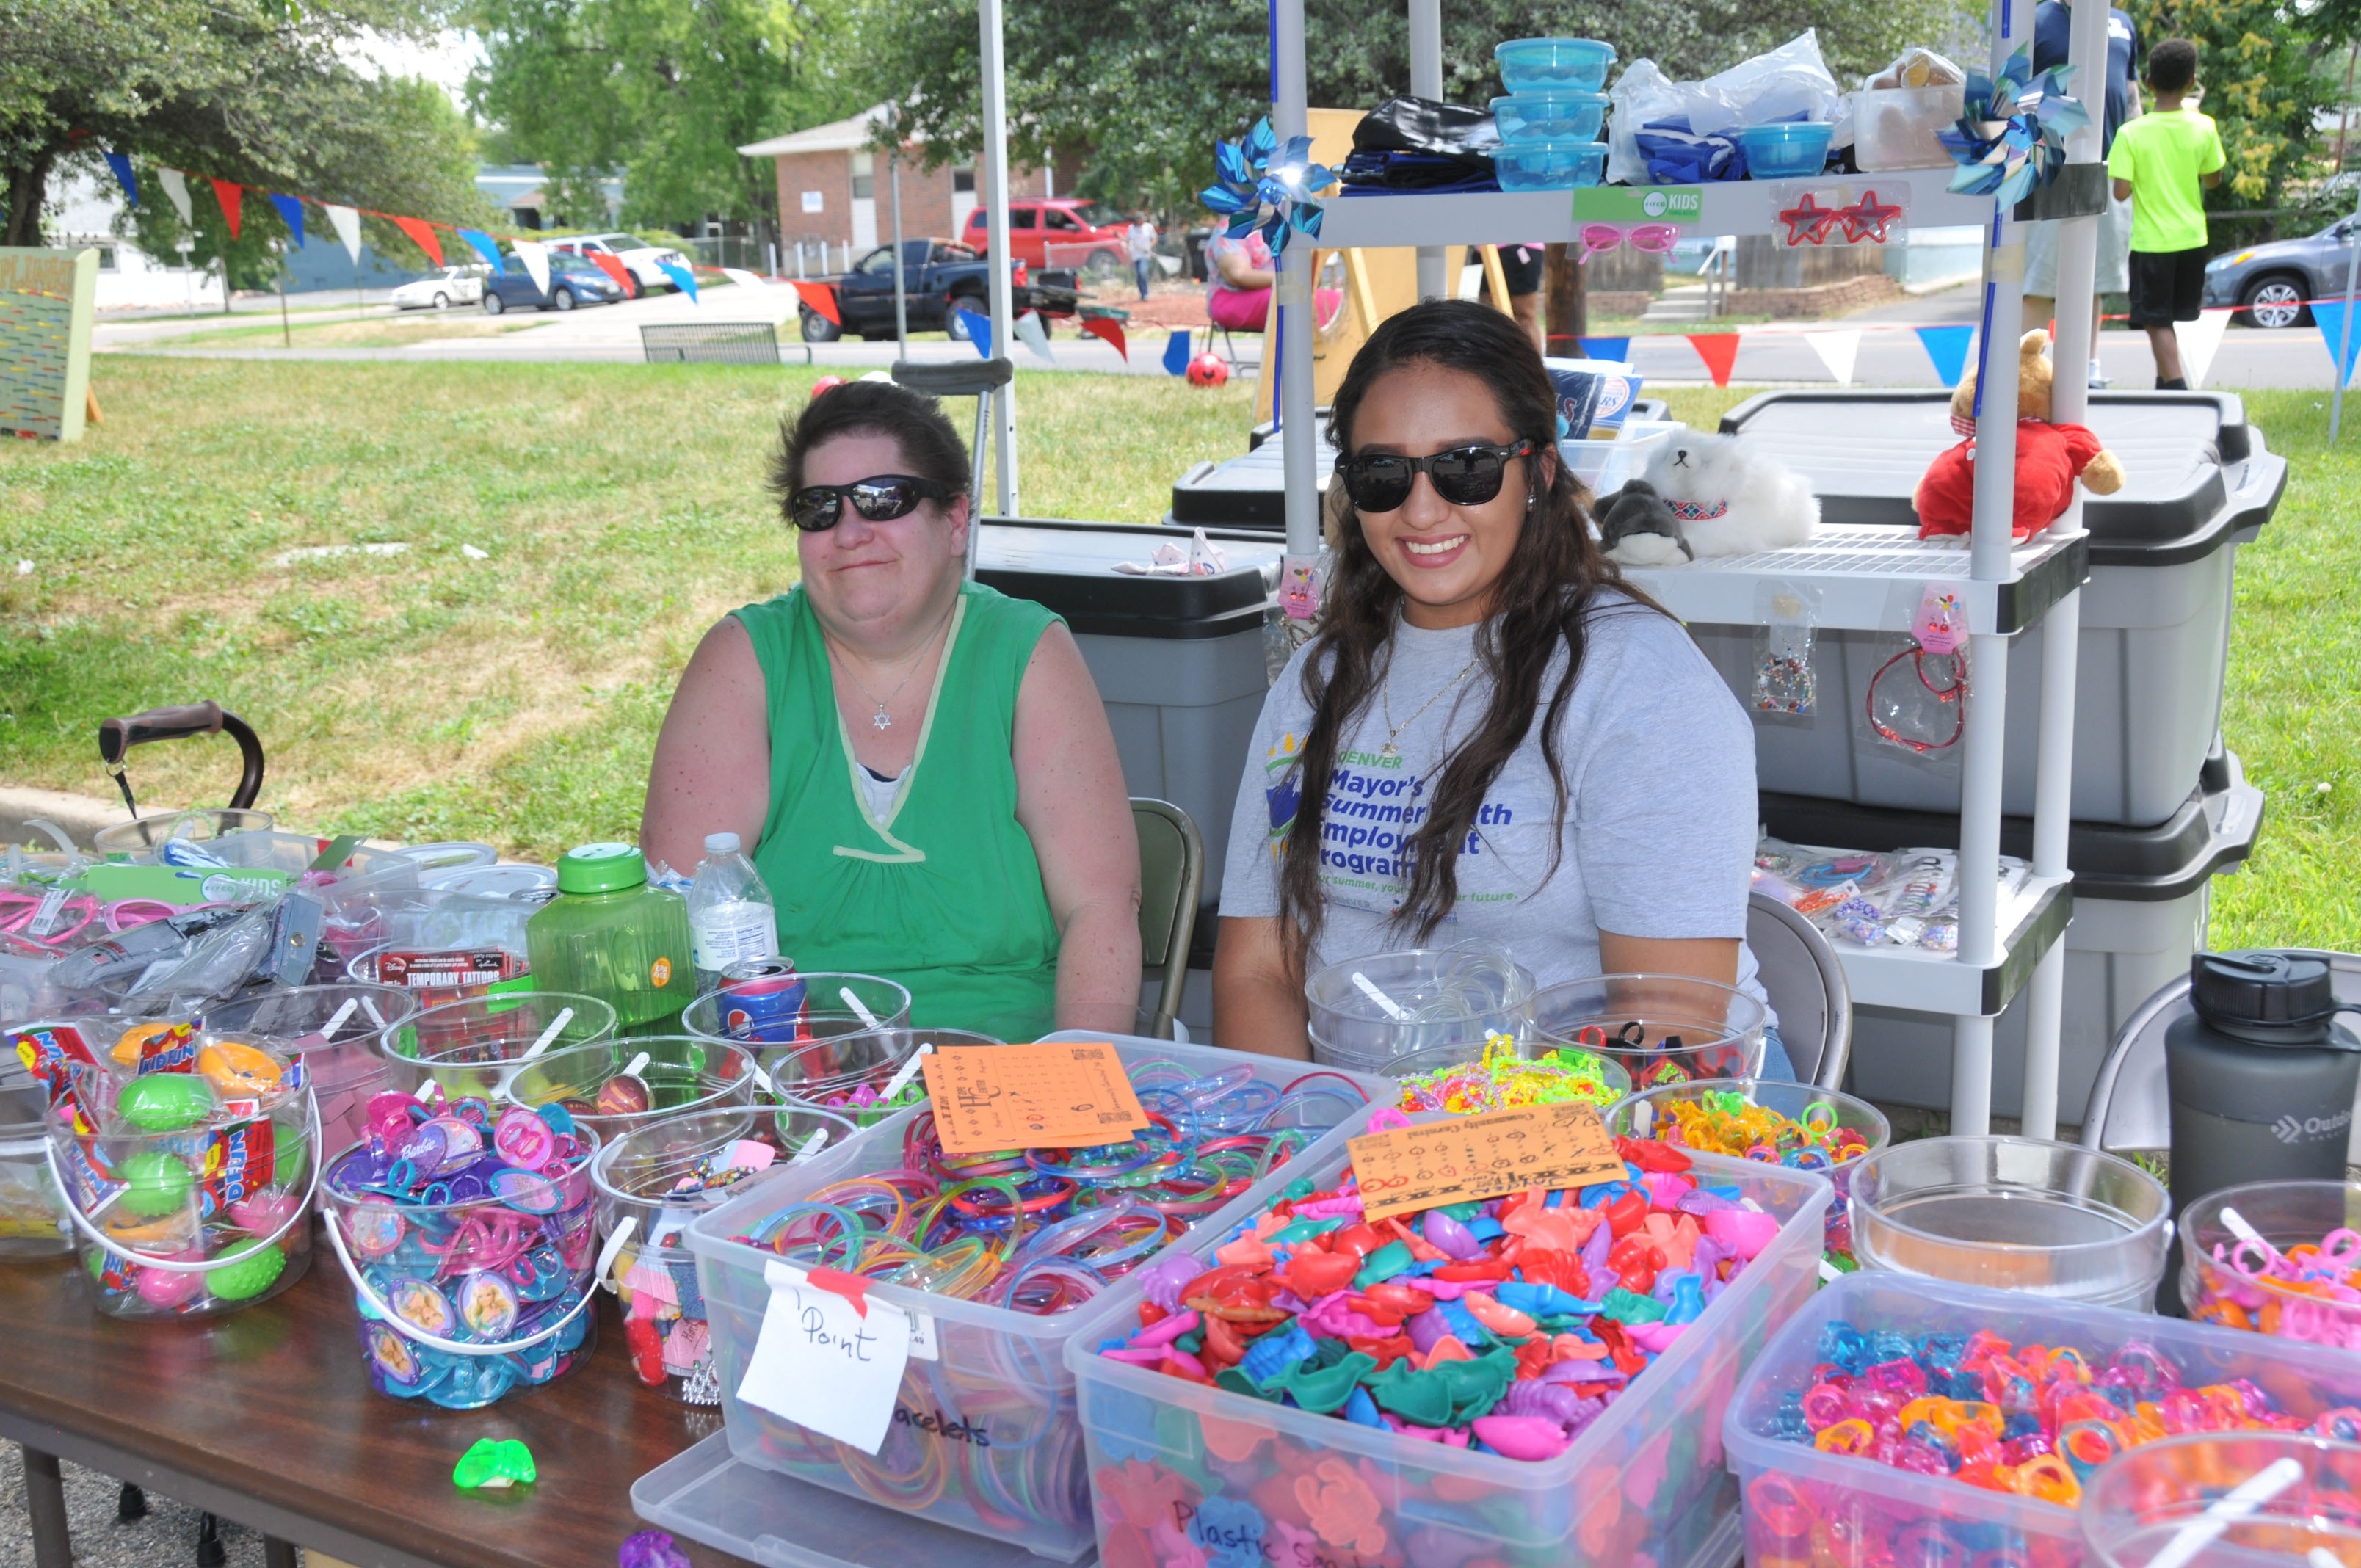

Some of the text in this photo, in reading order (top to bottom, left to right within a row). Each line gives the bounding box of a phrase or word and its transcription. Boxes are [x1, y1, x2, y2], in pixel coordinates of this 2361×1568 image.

[1669, 194, 1699, 210] KIDS
[1338, 751, 1403, 769] DENVER
[240, 878, 280, 899] KIDS
[384, 960, 406, 973] Disney
[407, 970, 501, 987] TEMPORARY TATTOOS
[139, 1040, 195, 1075] KIDFUN
[1407, 1113, 1535, 1140] Community Carnival
[401, 1137, 435, 1161] Barbie
[801, 1307, 877, 1362] Point
[893, 1408, 990, 1447] acelets
[1172, 1499, 1281, 1561] Plastic
